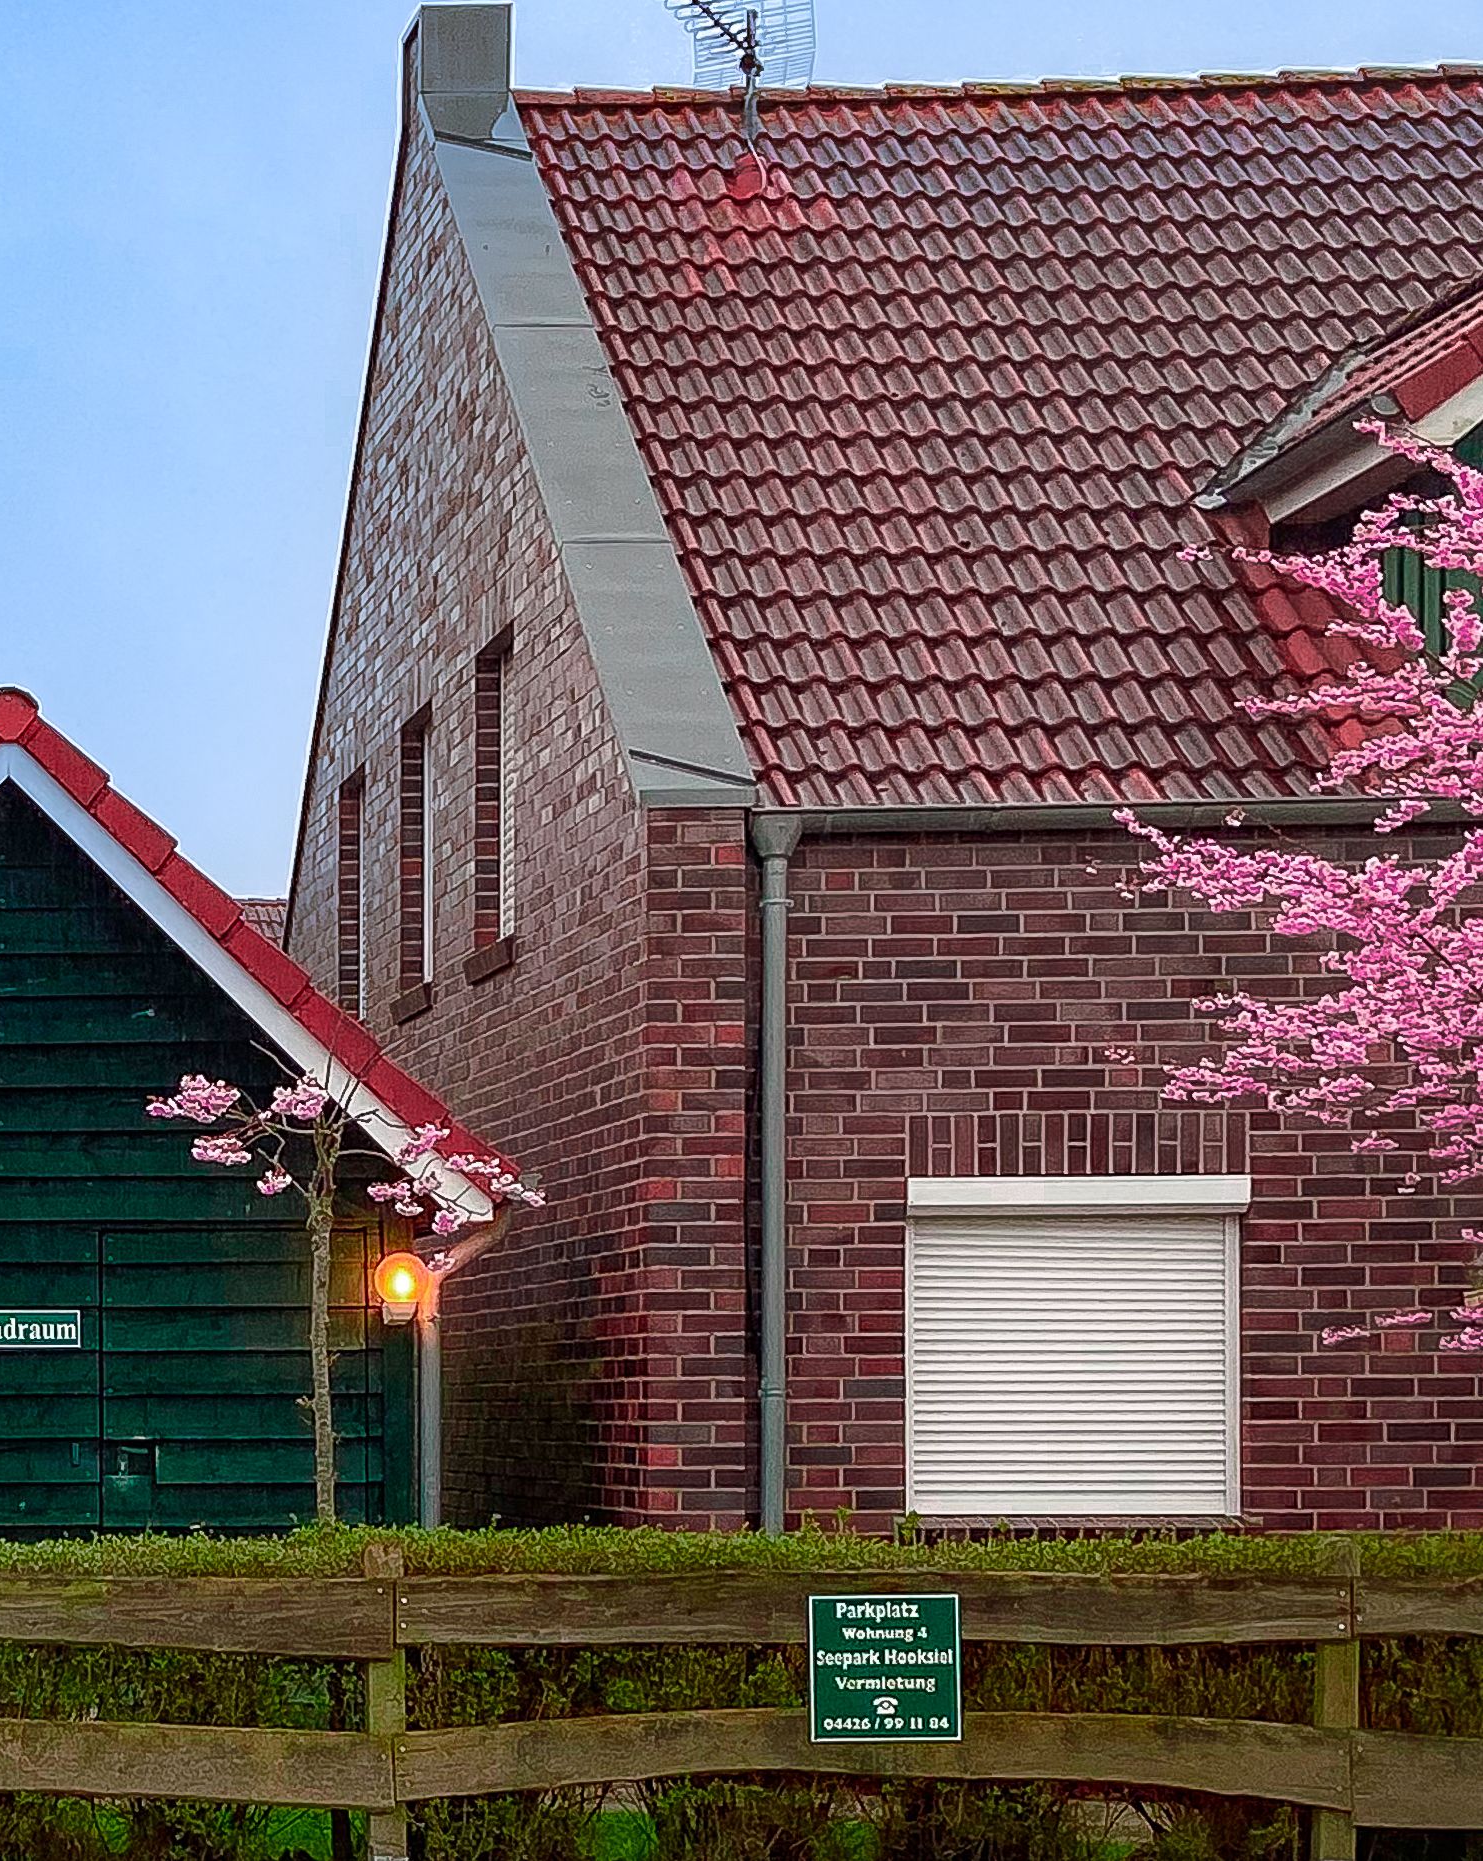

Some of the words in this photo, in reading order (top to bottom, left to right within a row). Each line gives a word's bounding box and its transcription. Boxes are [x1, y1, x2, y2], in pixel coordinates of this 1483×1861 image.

[836, 1601, 919, 1623] Parkplatz
[842, 1628, 914, 1642] Wohnung
[917, 1627, 927, 1638] 4
[817, 1649, 881, 1670] Seepark
[884, 1648, 953, 1665] Hooksiel
[835, 1676, 936, 1692] Vermietung
[823, 1718, 871, 1730] 04426
[884, 1718, 904, 1729] 99
[910, 1717, 922, 1729] 11
[929, 1717, 949, 1729] 84
